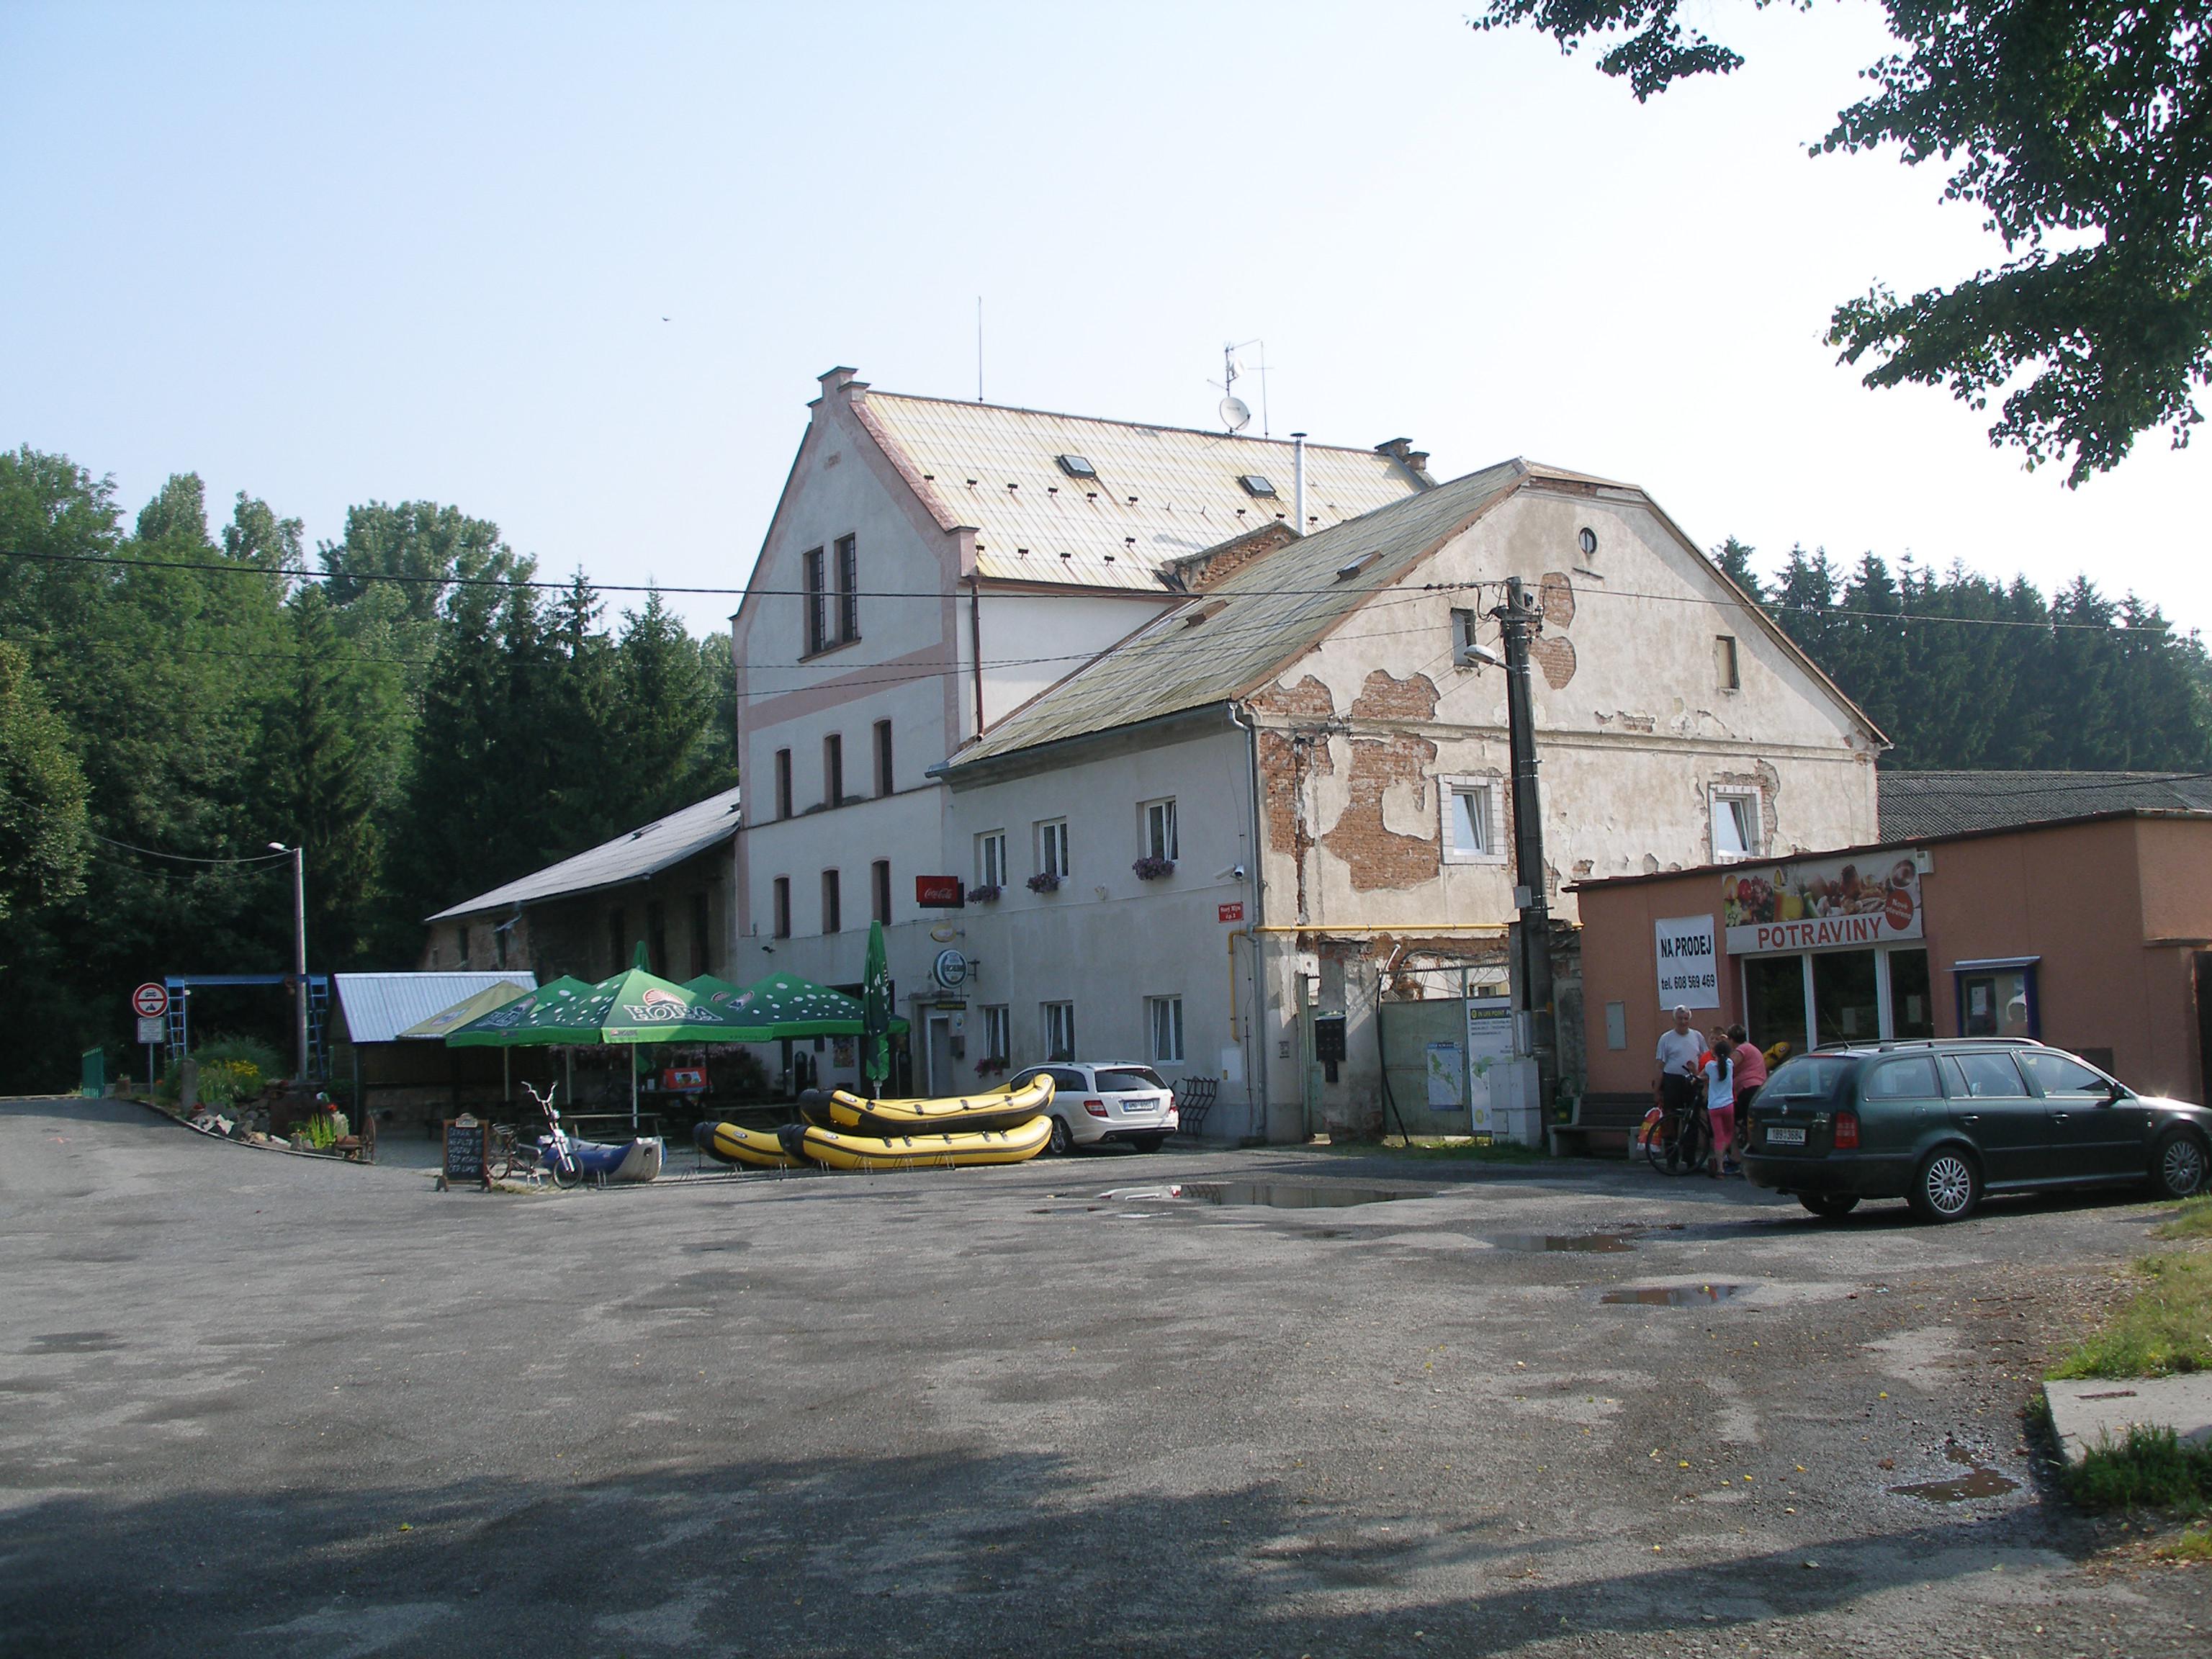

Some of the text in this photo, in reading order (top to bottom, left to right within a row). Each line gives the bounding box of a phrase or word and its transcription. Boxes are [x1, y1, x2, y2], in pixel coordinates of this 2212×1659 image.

[1758, 917, 1882, 949] POTRAVINY
[1660, 935, 1712, 958] NA PRODEJ
[1661, 977, 1673, 990] tel.
[1674, 976, 1686, 989] 608
[1701, 974, 1715, 988] 469
[623, 1003, 724, 1021] HOLBA
